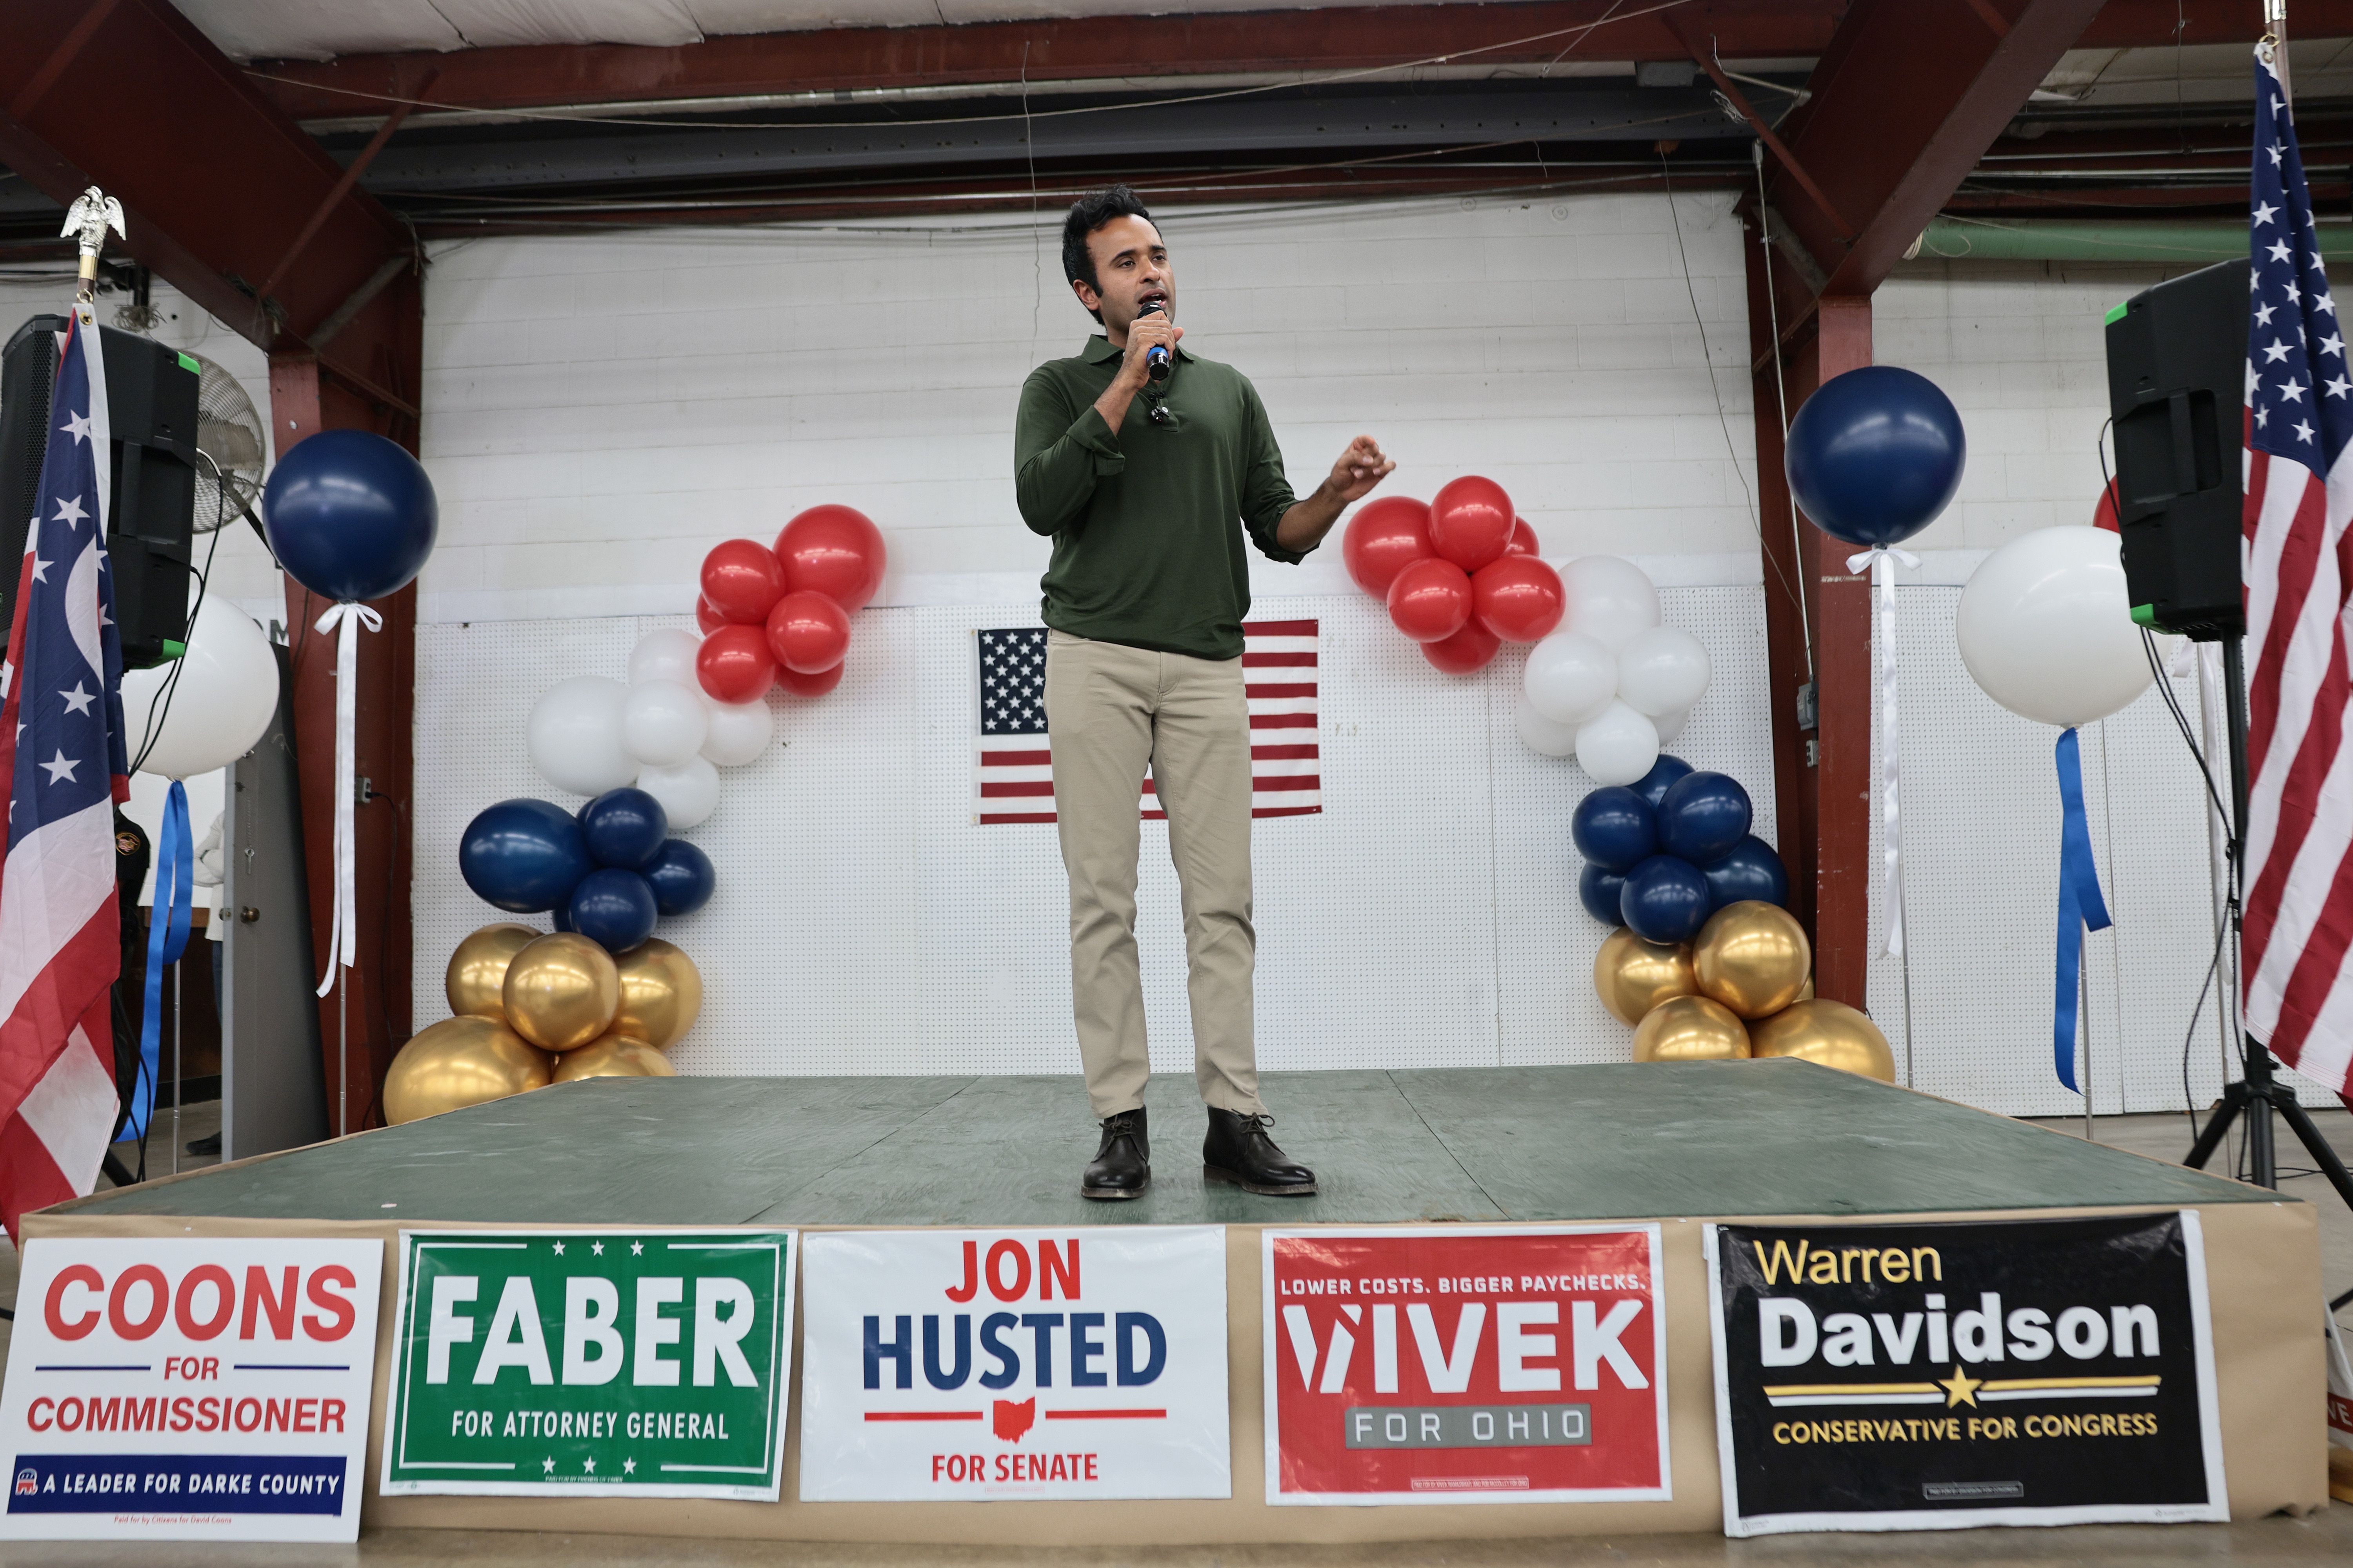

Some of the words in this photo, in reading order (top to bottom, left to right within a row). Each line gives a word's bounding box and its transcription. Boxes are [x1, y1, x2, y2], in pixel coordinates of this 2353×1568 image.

[945, 1239, 1081, 1303] JON
[1754, 1239, 1942, 1285] Warren
[1281, 1279, 1351, 1295] LOWER
[1360, 1277, 1431, 1294] COSTS.
[1438, 1276, 1513, 1293] BIGGER
[1521, 1273, 1646, 1292] PAYCHECKS.
[44, 1264, 356, 1342] COONS
[426, 1276, 758, 1387] FABER
[1282, 1299, 1649, 1394] VIVEK
[1759, 1292, 2160, 1367] Davidson
[164, 1356, 219, 1381] FOR
[864, 1312, 1167, 1390] HUSTED
[27, 1396, 346, 1433] COMMISSIONER
[452, 1411, 493, 1436] FOR
[504, 1411, 617, 1437] ATTORNEY
[627, 1412, 729, 1439] GENERAL
[1355, 1414, 1441, 1442] FOR
[1472, 1410, 1584, 1440] OHIO
[1773, 1418, 1960, 1444] CONSERVATIVE
[1968, 1417, 2017, 1440] FOR
[2024, 1413, 2158, 1438] CONGRESS
[43, 1474, 55, 1494] A
[64, 1474, 136, 1493] LEADER
[144, 1474, 180, 1494] FOR
[189, 1474, 251, 1494] DARKE
[259, 1475, 340, 1495] COUNTY
[932, 1454, 986, 1483] FOR
[995, 1453, 1098, 1483] SENATE
